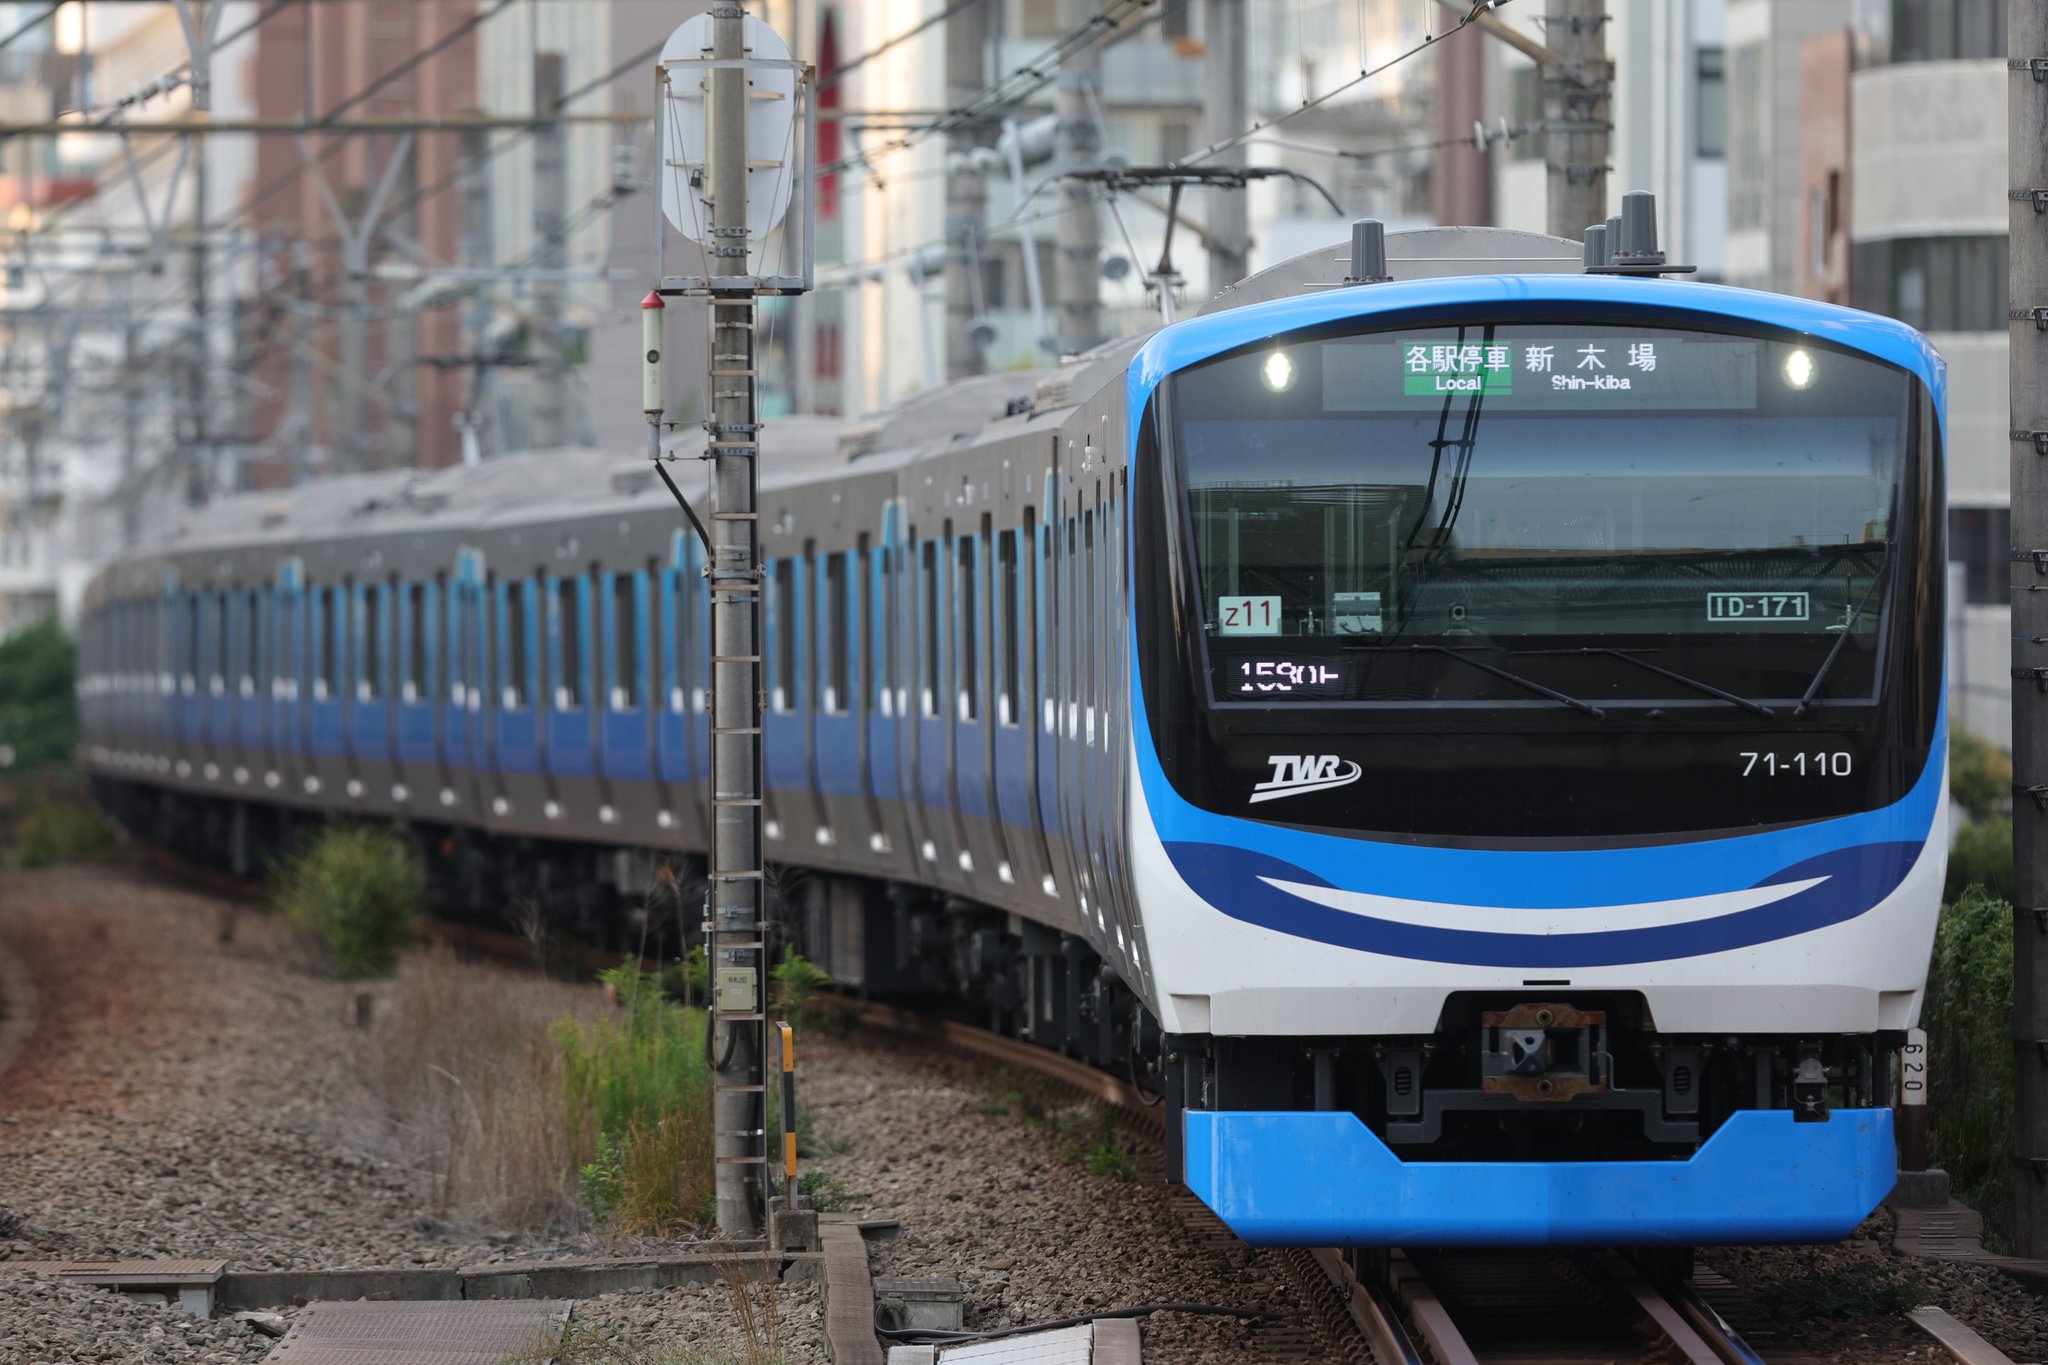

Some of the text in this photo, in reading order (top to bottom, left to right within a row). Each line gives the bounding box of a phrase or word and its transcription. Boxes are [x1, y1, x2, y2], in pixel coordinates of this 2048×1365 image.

[1406, 344, 1657, 372] 各駅停車 新木場
[1435, 375, 1631, 391] Local Shin-kiba
[1716, 597, 1803, 616] ID-171
[1739, 752, 1852, 776] 71-110
[1904, 1044, 1924, 1091] 620
